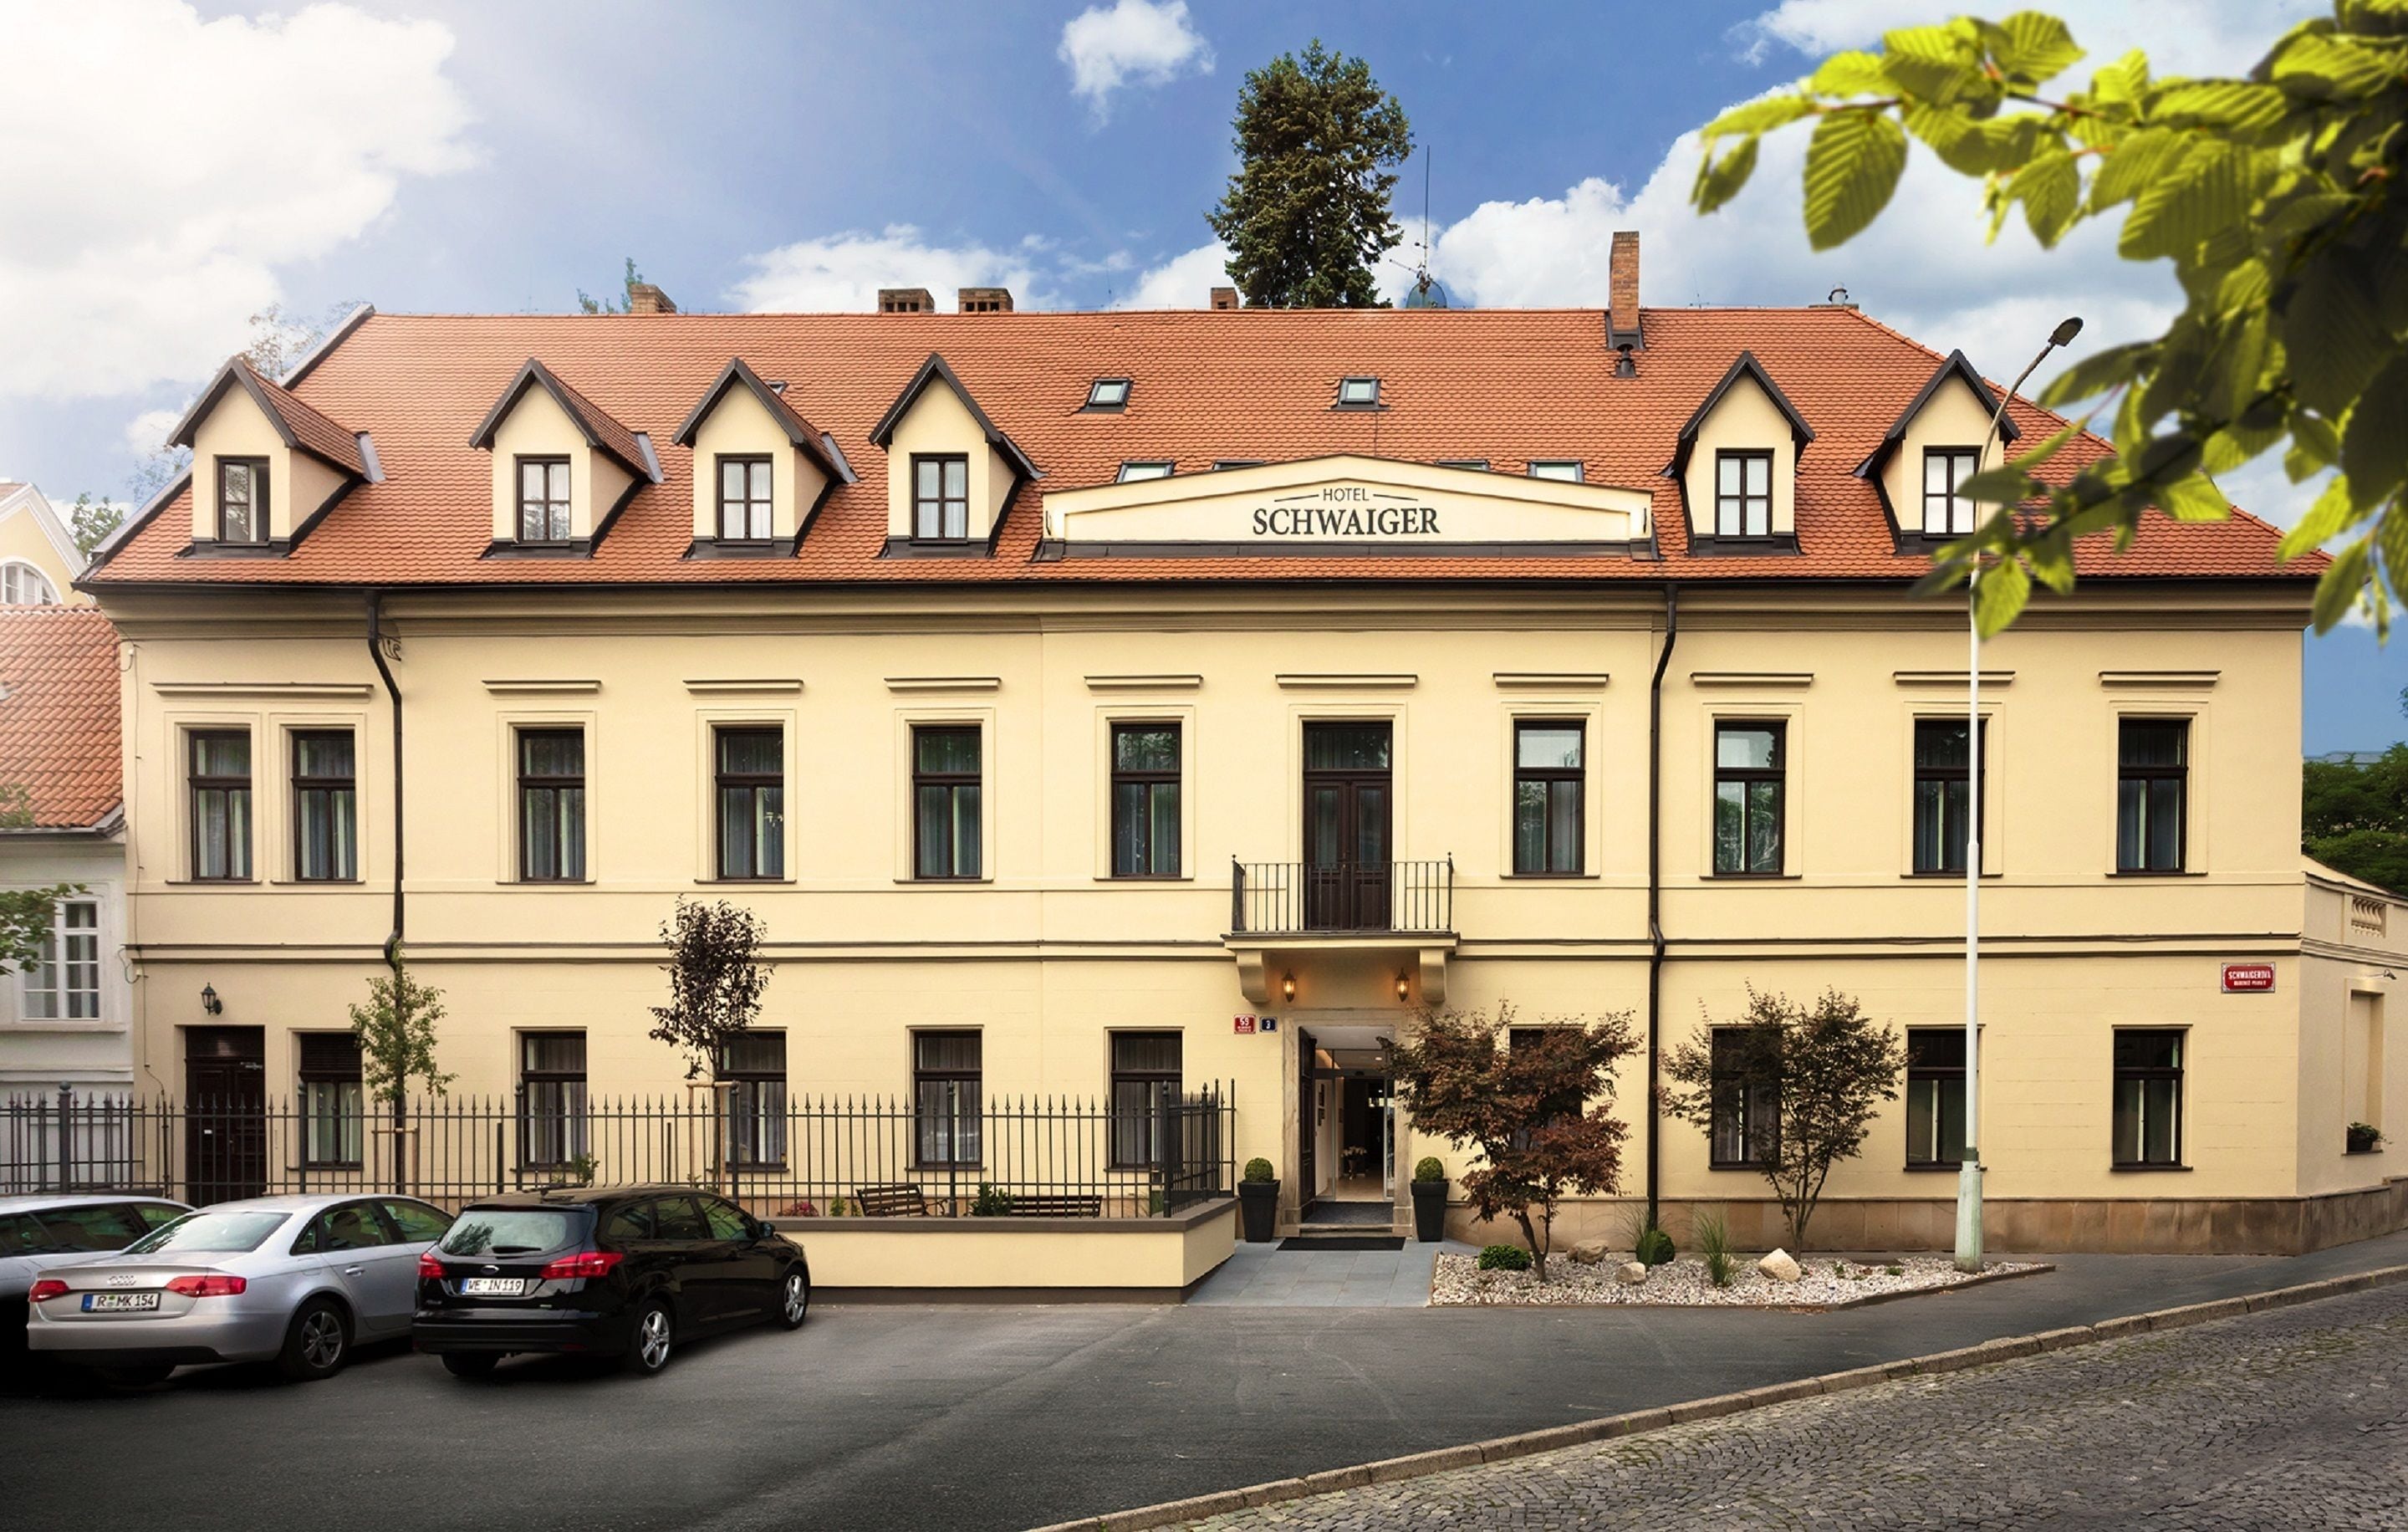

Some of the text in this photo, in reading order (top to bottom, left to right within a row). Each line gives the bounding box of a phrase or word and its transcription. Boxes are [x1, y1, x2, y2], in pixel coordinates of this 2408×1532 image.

[1323, 488, 1370, 502] HOTEL
[1252, 508, 1441, 535] SCHWAIGER
[1239, 1017, 1249, 1026] 59
[1266, 1020, 1271, 1029] 3
[468, 1280, 481, 1290] WE
[97, 1295, 107, 1306] R
[135, 1295, 154, 1306] 154
